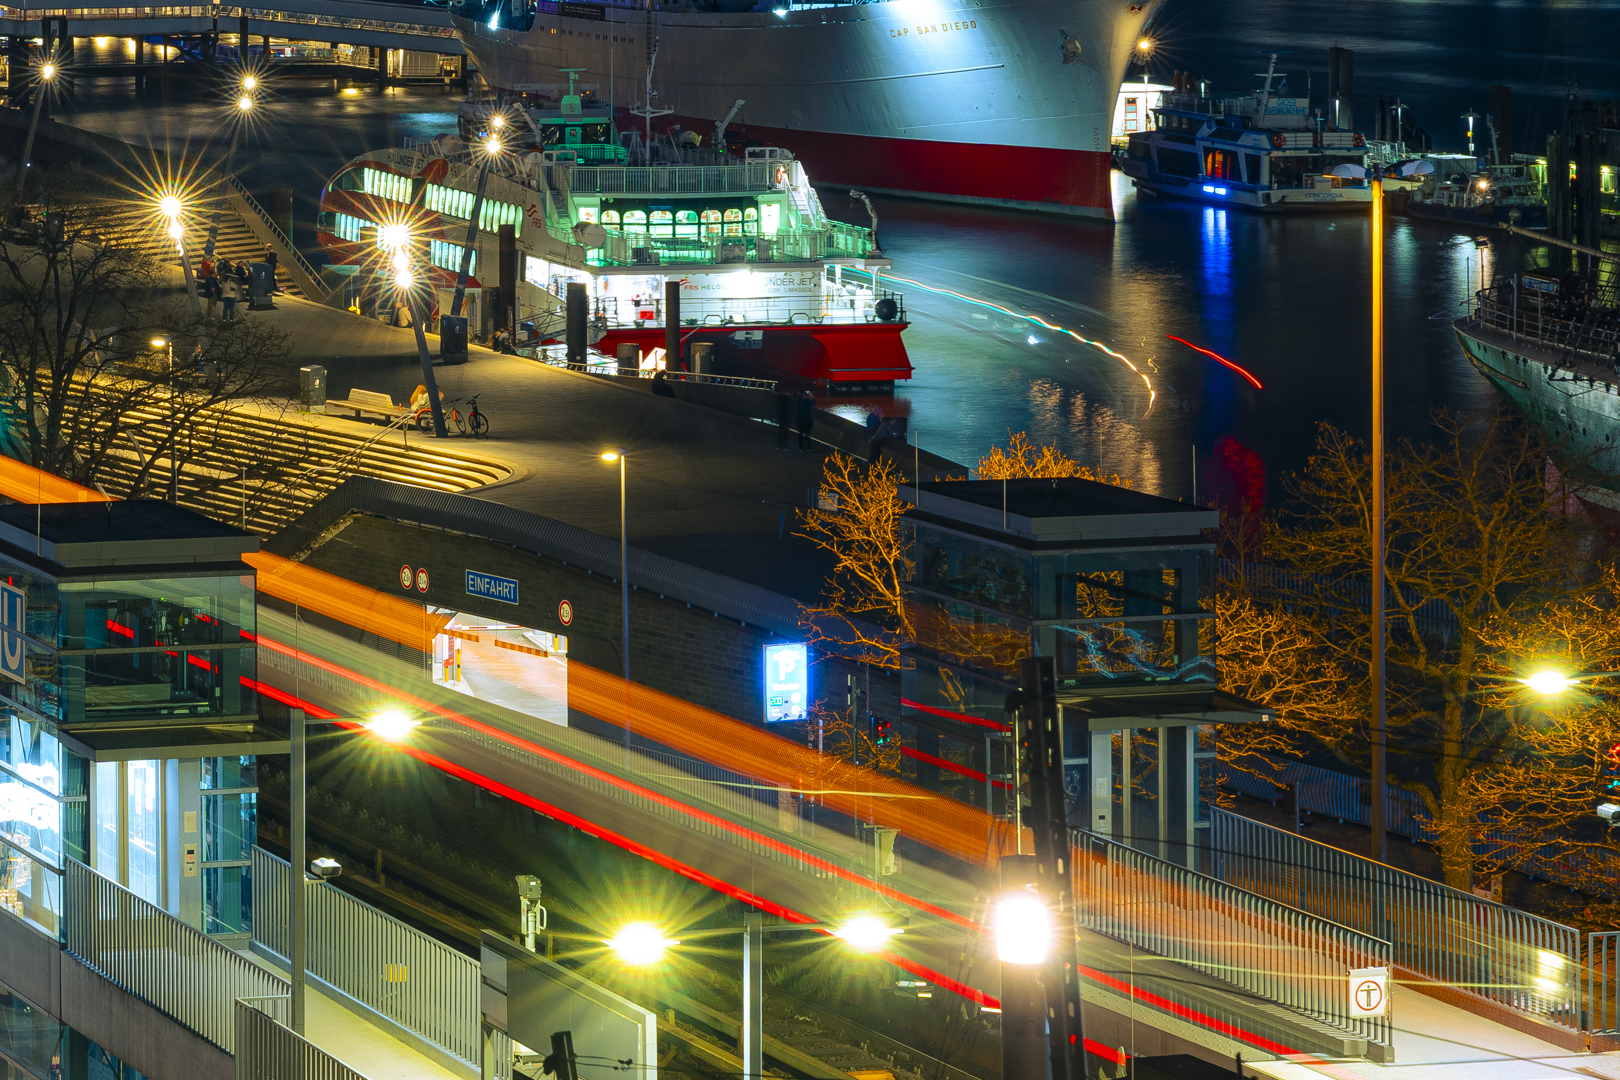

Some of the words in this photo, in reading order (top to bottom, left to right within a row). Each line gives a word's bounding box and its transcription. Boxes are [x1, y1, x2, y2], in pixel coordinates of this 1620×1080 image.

[890, 28, 908, 38] CAP
[917, 25, 937, 34] SAN
[942, 20, 977, 32] DIEGO
[797, 277, 813, 286] JET
[468, 575, 516, 600] EINFAHRT
[3, 590, 22, 671] U
[779, 659, 796, 681] P
